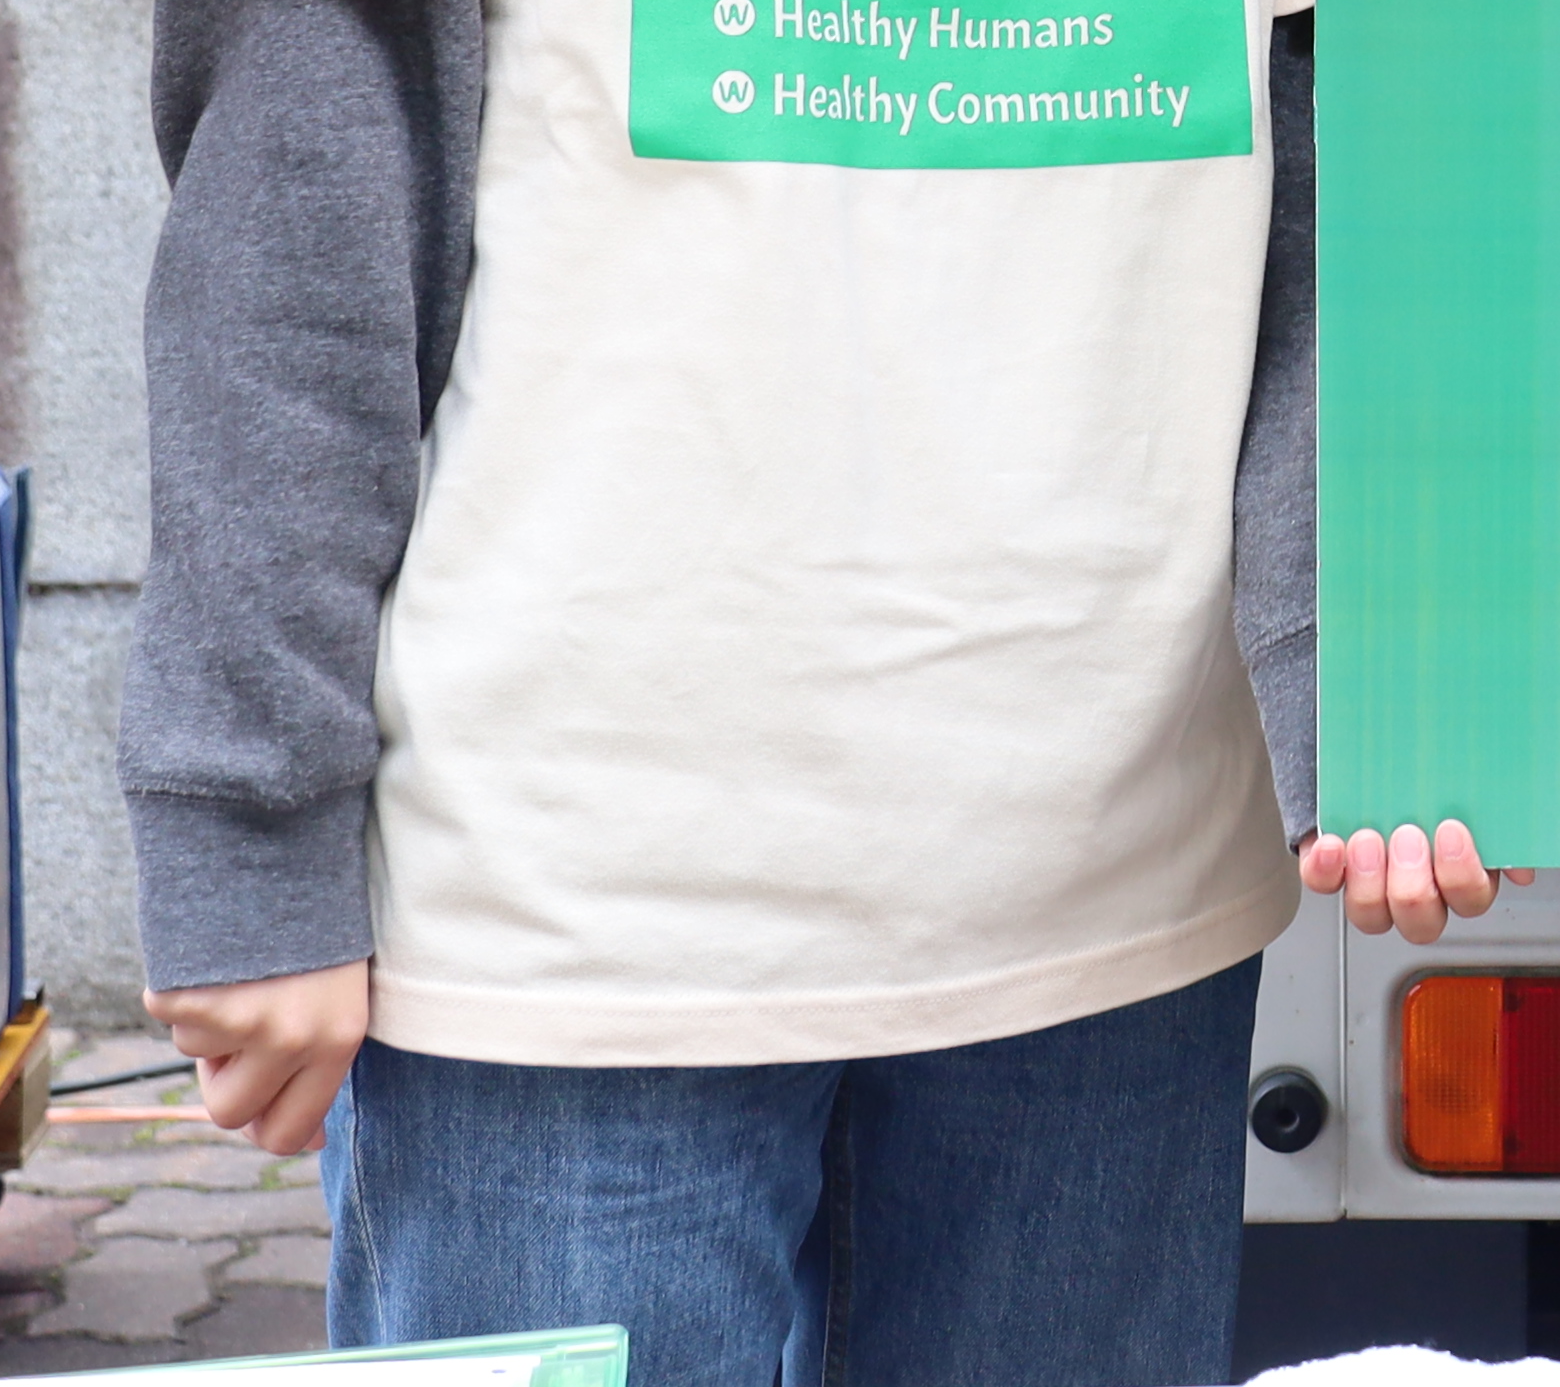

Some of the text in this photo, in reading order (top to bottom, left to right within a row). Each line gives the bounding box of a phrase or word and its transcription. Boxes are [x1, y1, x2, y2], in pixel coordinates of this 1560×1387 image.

[929, 7, 1114, 50] Humans
[774, 73, 1190, 136] Healthy Community
